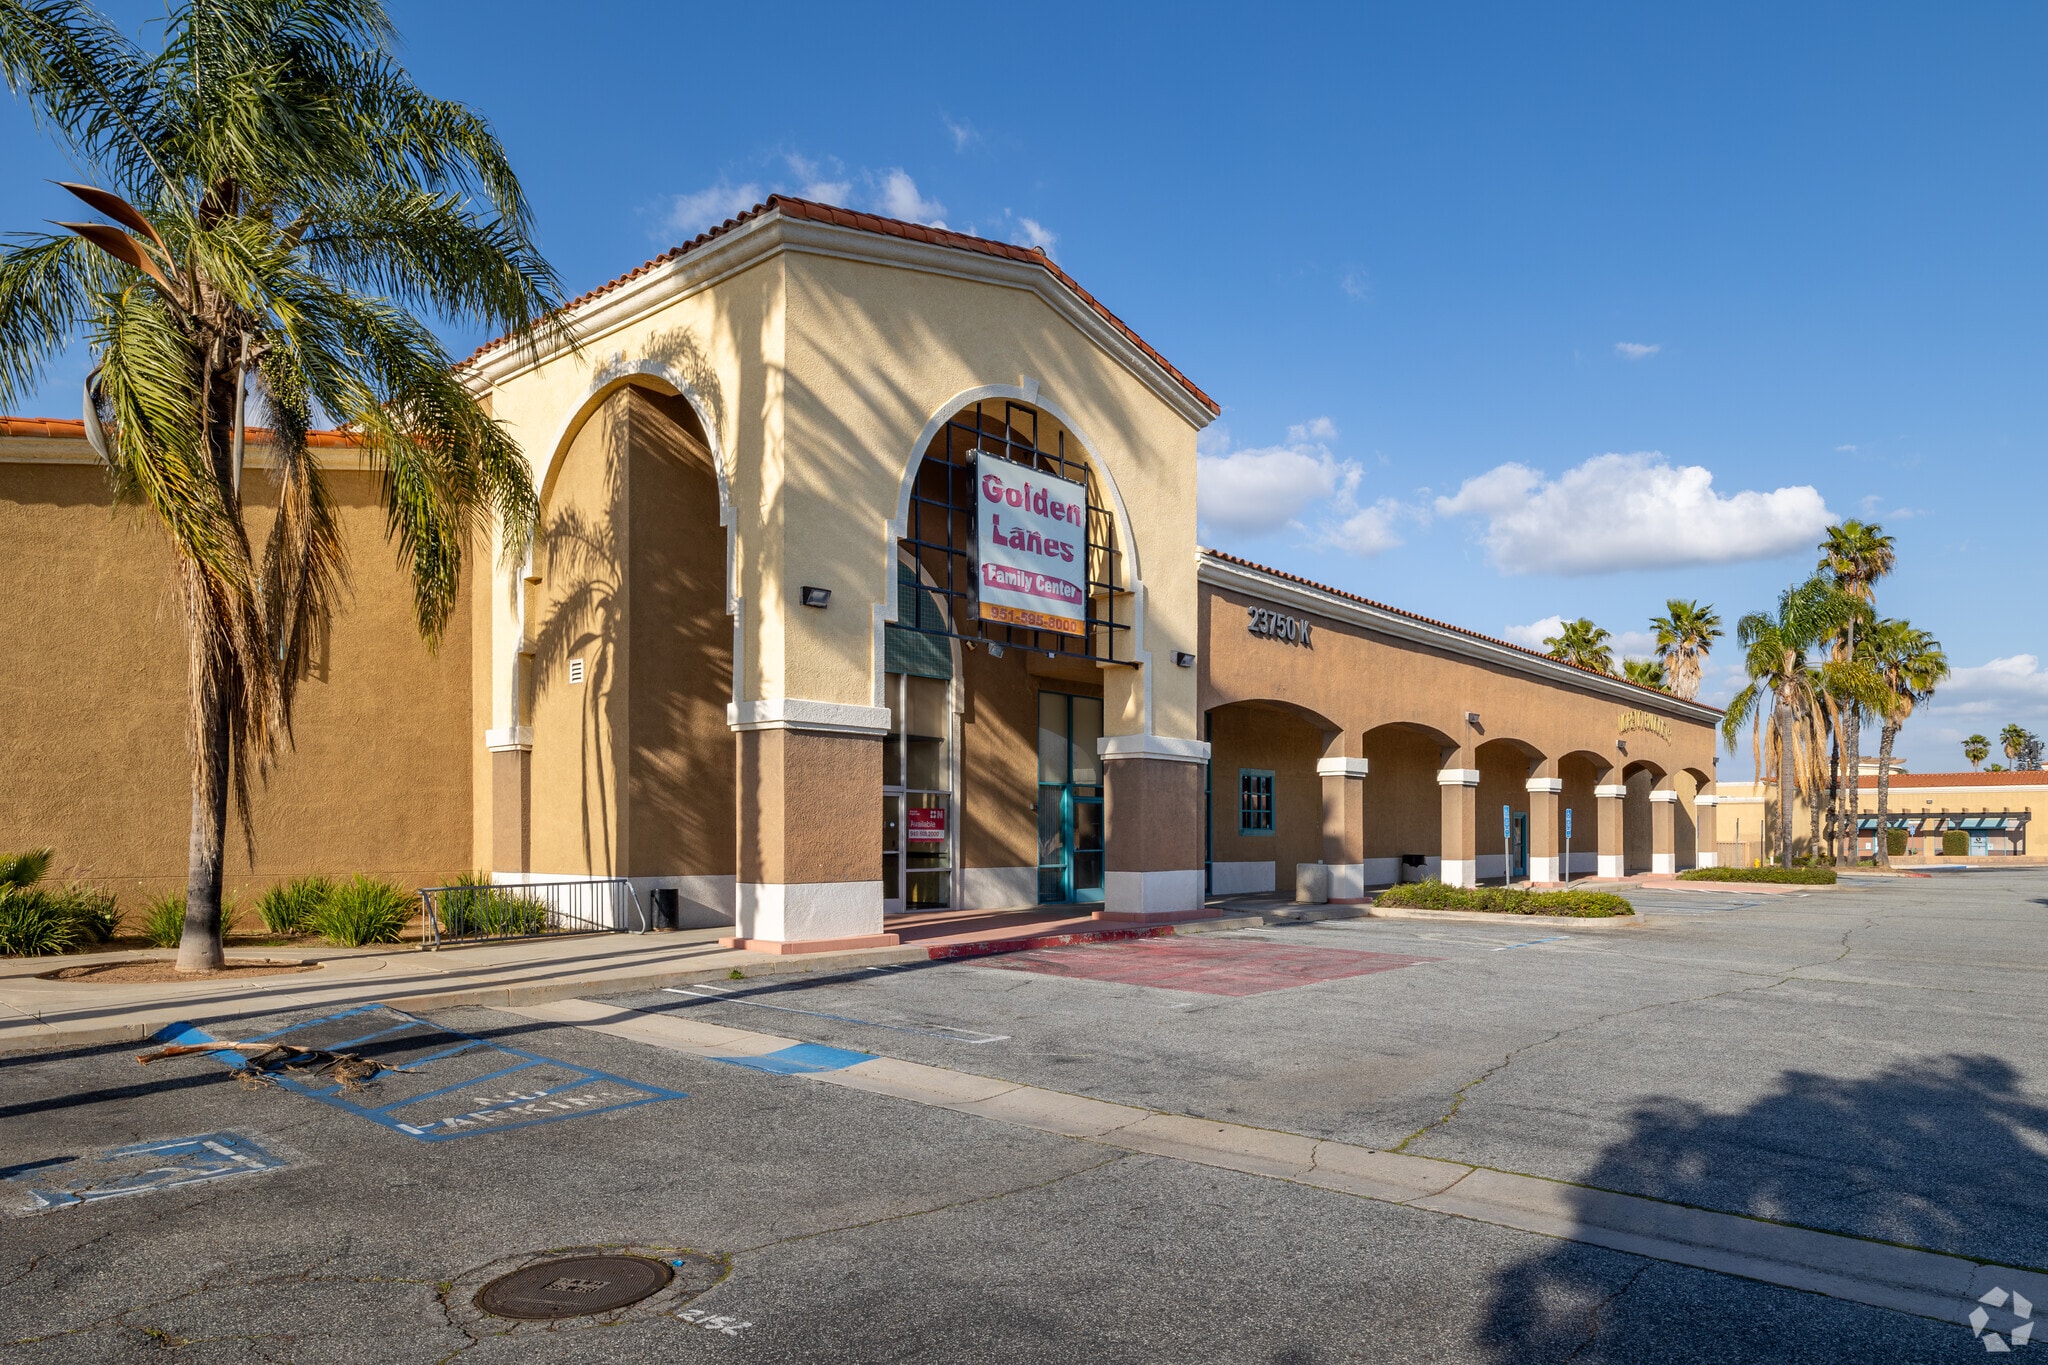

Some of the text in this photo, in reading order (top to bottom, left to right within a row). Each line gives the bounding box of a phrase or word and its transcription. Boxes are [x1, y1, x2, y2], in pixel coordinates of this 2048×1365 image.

[981, 473, 1082, 528] Golden
[992, 513, 1074, 563] Lanes
[987, 563, 1076, 599] Family Center
[1247, 605, 1310, 643] 23750 K
[910, 820, 936, 828] Available
